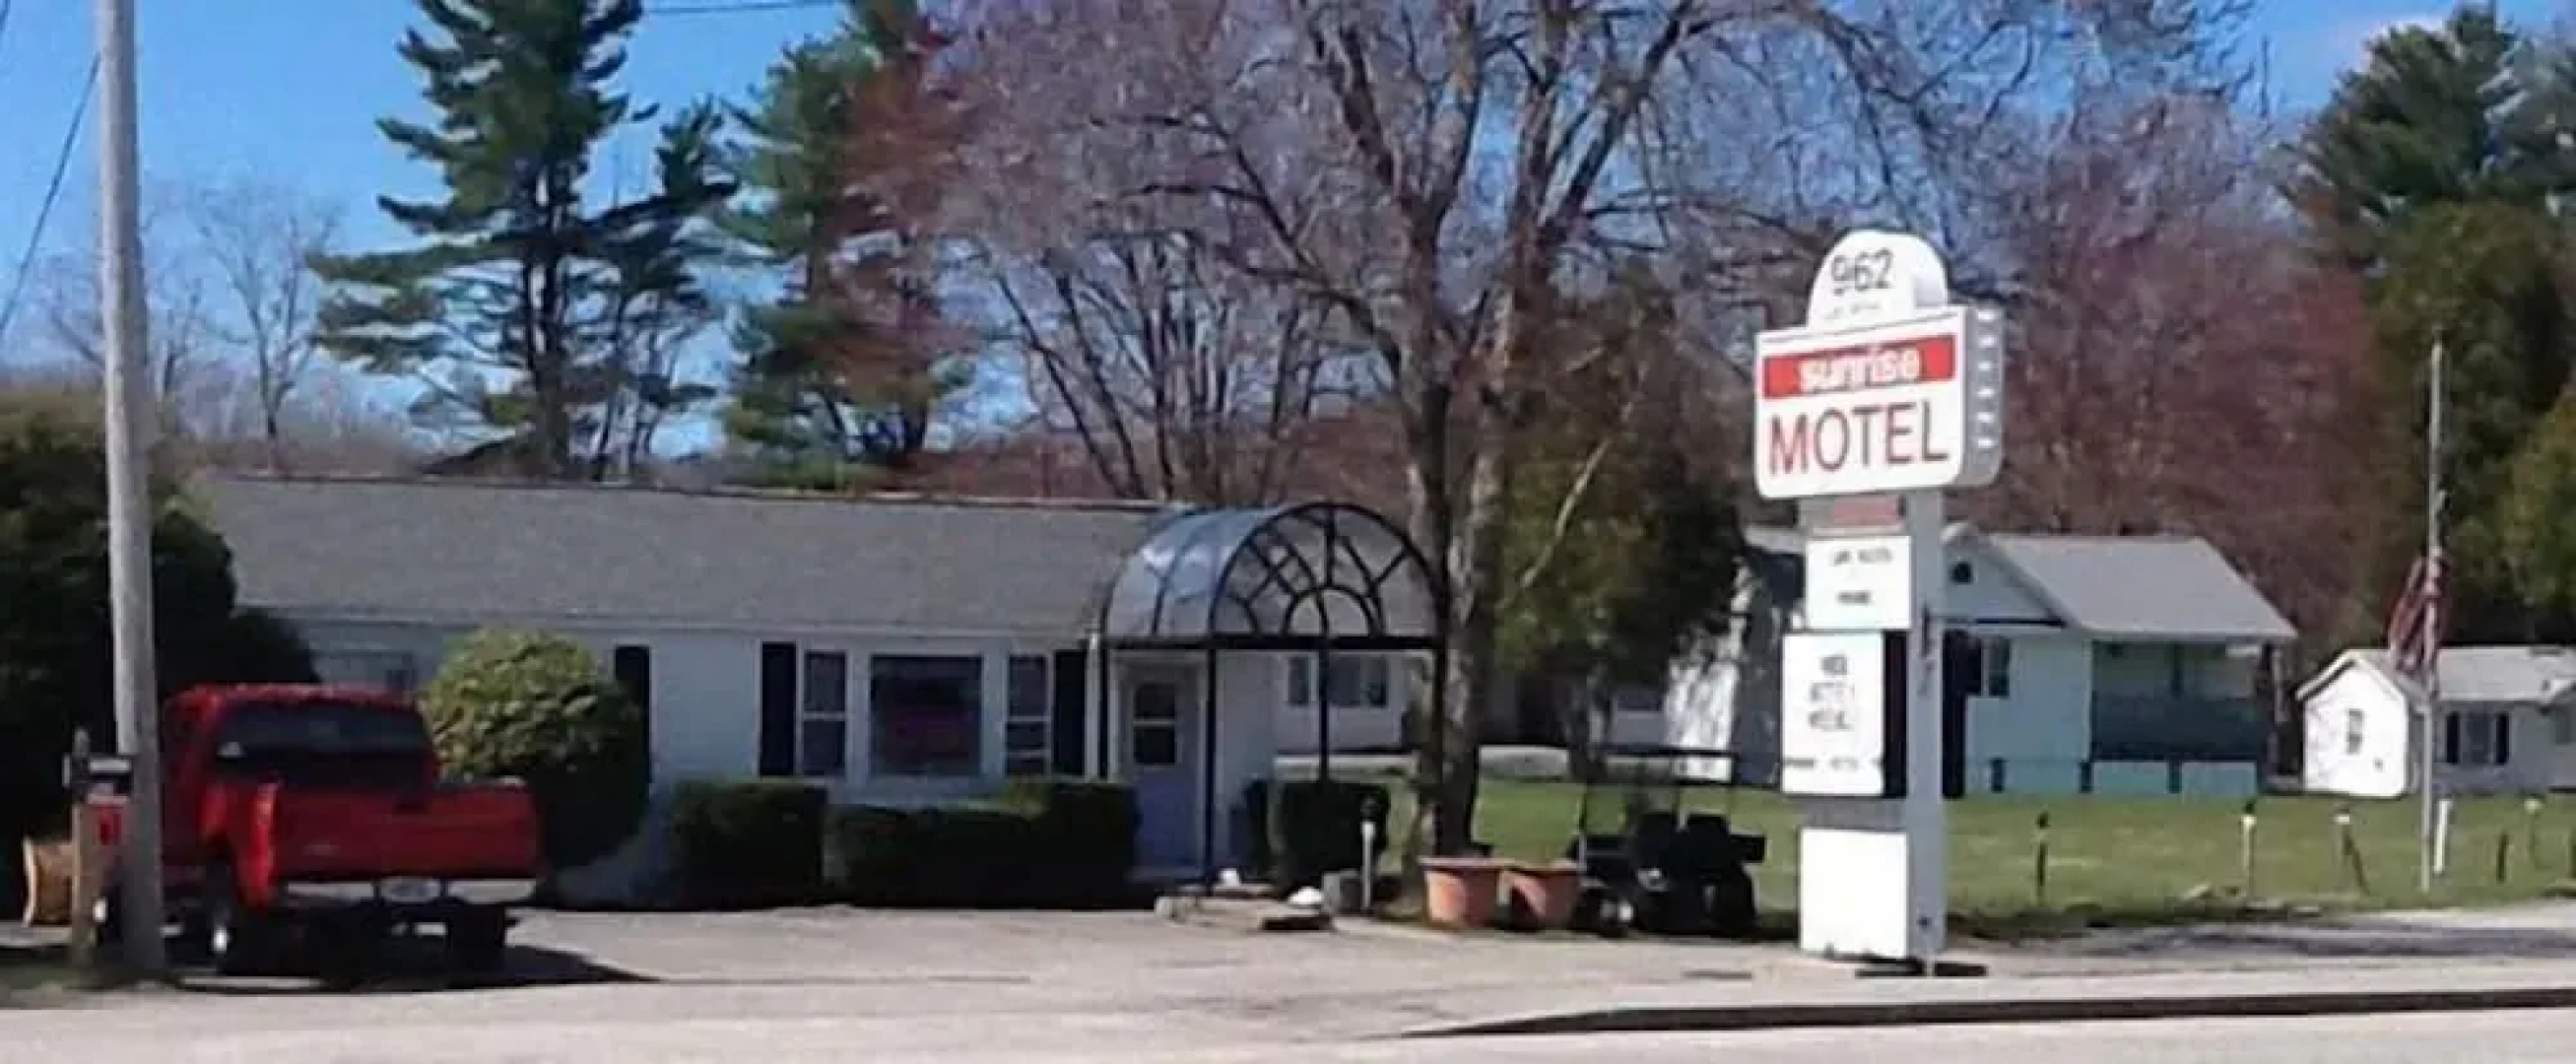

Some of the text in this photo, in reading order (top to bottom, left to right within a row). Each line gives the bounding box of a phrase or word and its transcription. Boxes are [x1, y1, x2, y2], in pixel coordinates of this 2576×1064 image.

[1829, 247, 1894, 296] 962
[1799, 345, 1921, 391] sunrise
[1769, 398, 1949, 477] MOTEL
